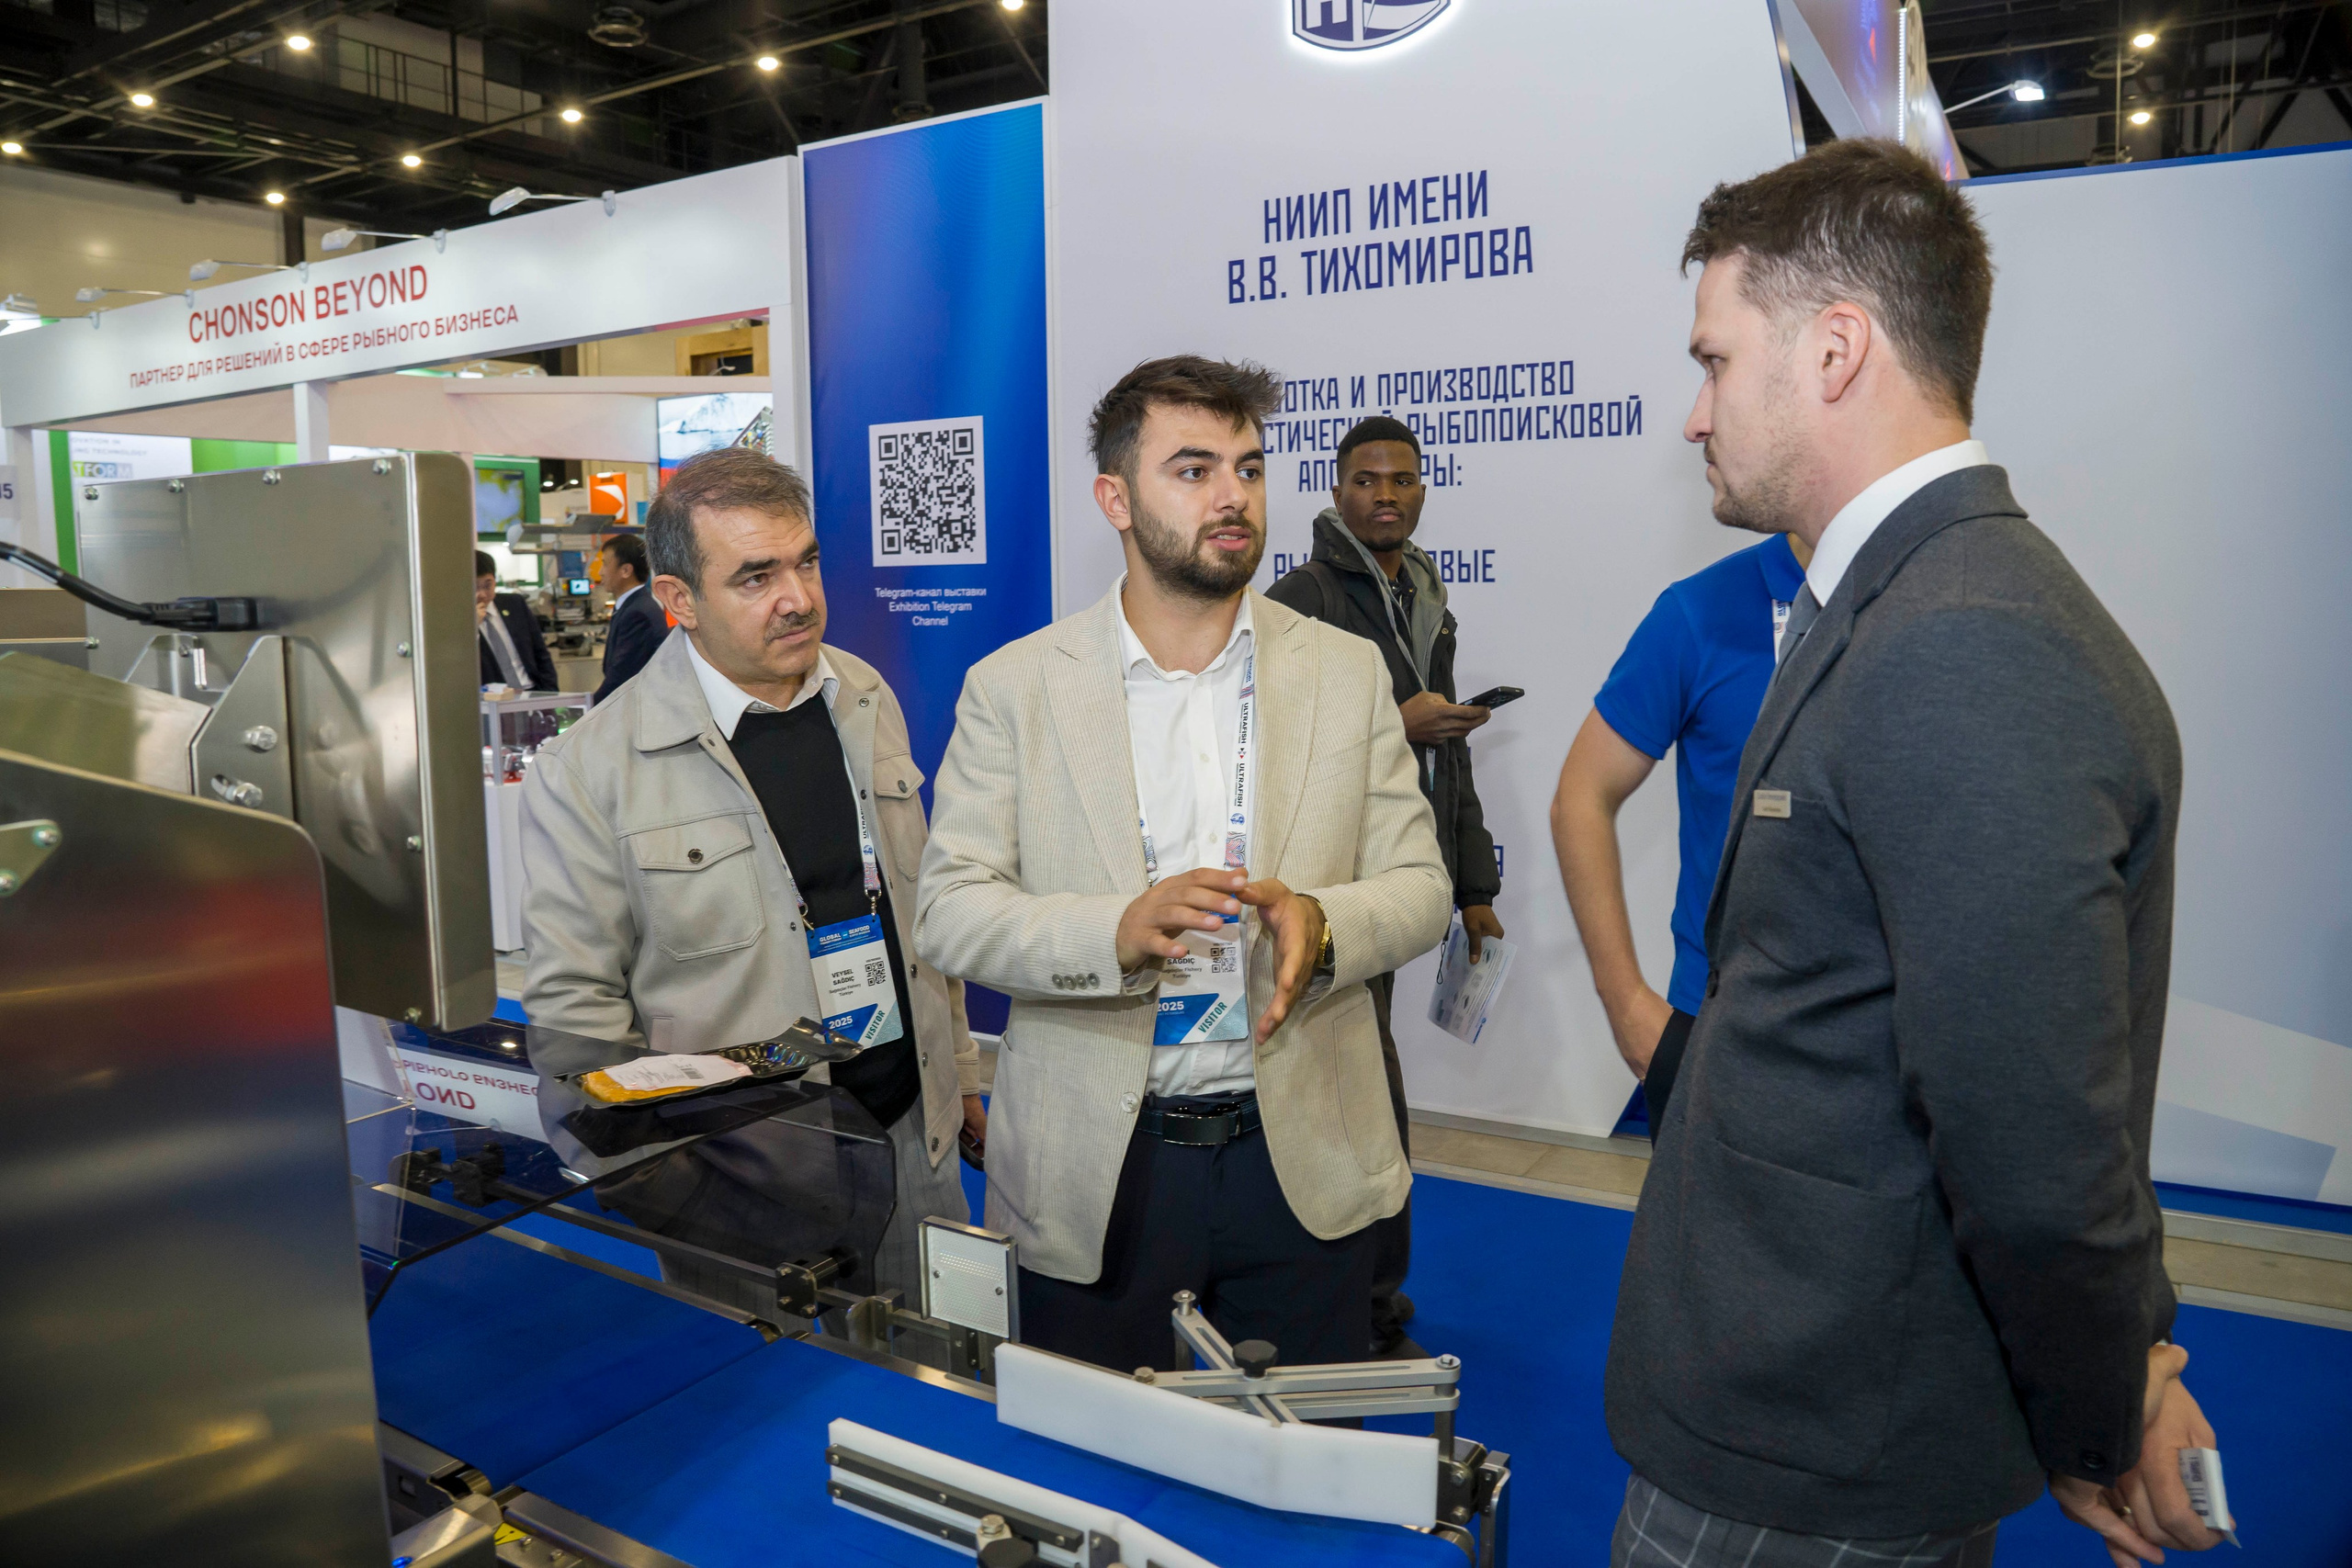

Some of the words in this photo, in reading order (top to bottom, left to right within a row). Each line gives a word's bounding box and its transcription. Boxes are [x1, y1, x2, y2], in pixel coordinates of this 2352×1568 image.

[1264, 188, 1351, 243] НИИП
[1369, 170, 1488, 231] ИМЕНИ
[1228, 255, 1287, 304] В.В.
[1301, 226, 1533, 296] ТИХОМИРОВА
[188, 290, 305, 344] CHONSON
[314, 265, 427, 320] BEYOND
[130, 365, 184, 389] ПАРТНЕР
[187, 359, 213, 381] ДЛЯ
[216, 342, 283, 374] РЕШЕНИЙ
[287, 344, 295, 362] В
[299, 335, 349, 359] СФЕРЕ
[353, 321, 430, 350] РЫБНОГО
[435, 304, 519, 336] БИЗНЕСА
[1351, 376, 1365, 408] И
[1378, 360, 1574, 407] ПРОИЗВОДСТВО
[875, 588, 943, 600] Telegram-канал
[944, 588, 987, 597] выставки
[888, 602, 930, 612] Exhibition
[932, 601, 973, 614] Telegram
[911, 615, 948, 626] Channel
[1158, 1000, 1184, 1012] 2025
[1198, 1001, 1227, 1033] VISITOR
[828, 1015, 854, 1030] 2025
[865, 1010, 886, 1041] VISITOR
